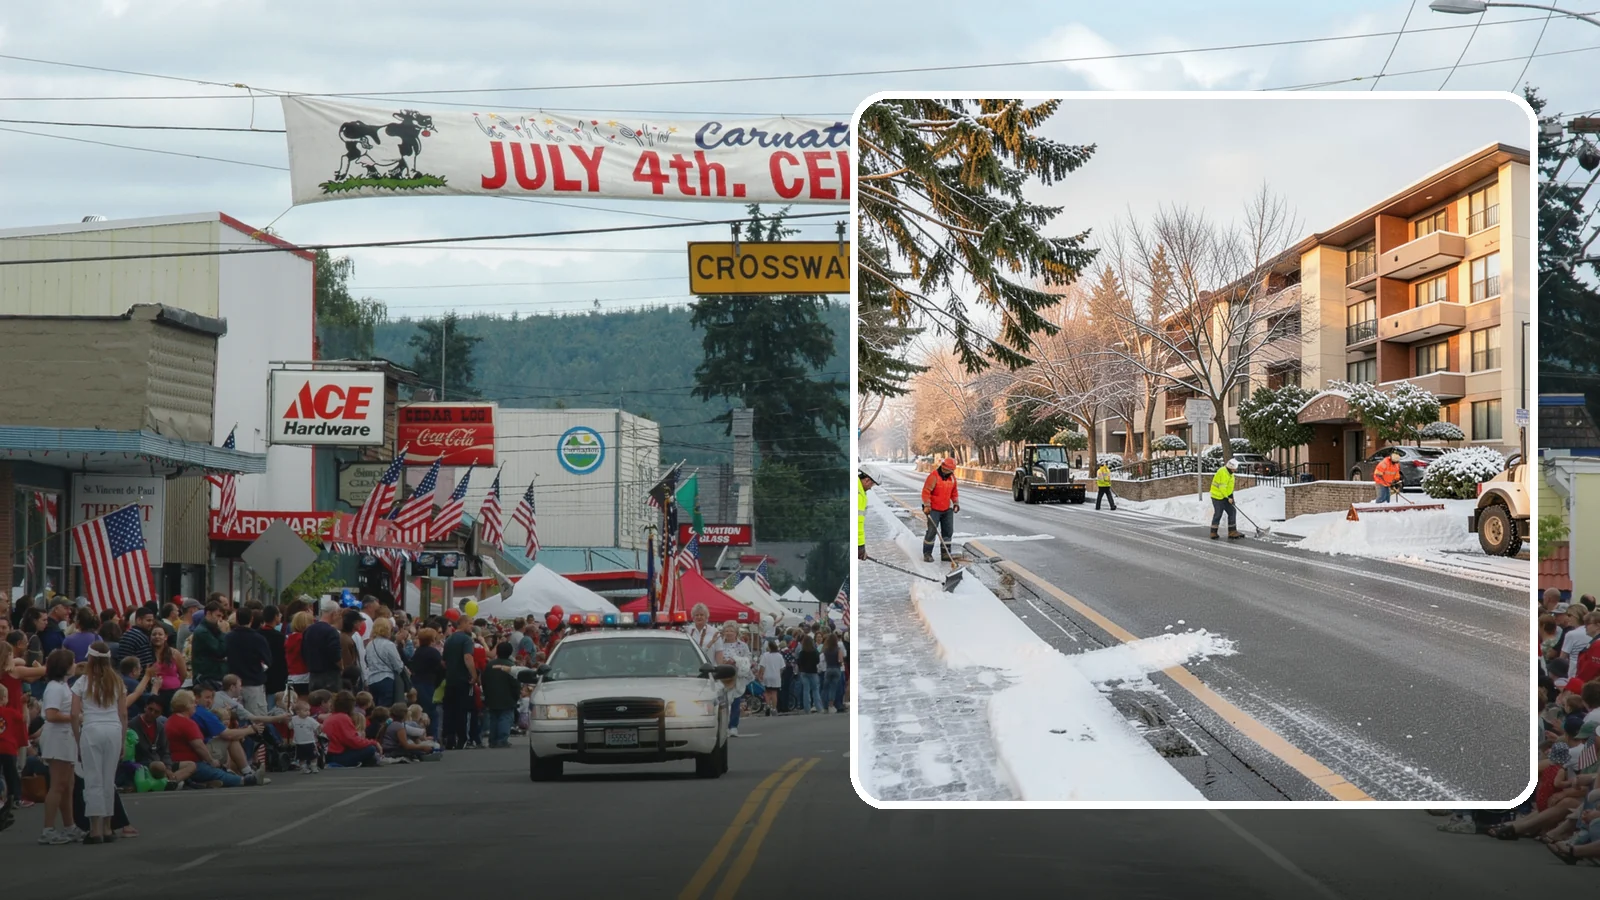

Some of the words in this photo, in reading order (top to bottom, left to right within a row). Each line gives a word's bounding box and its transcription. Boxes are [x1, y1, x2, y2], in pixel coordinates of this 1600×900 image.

[694, 121, 850, 150] Carnat
[481, 141, 605, 192] JULY
[632, 150, 746, 197] 4th.
[697, 254, 850, 280] CROSSWA
[283, 380, 373, 420] ACE
[406, 409, 452, 422] CEDAR
[284, 421, 370, 437] Hardware
[416, 428, 477, 447] Coca-Cola
[83, 484, 94, 494] St.
[95, 484, 124, 495] Vincent
[126, 485, 135, 495] de
[137, 485, 155, 495] Paul
[81, 503, 154, 522] THT
[688, 526, 741, 535] CRNATION
[699, 535, 730, 543] GLASS
